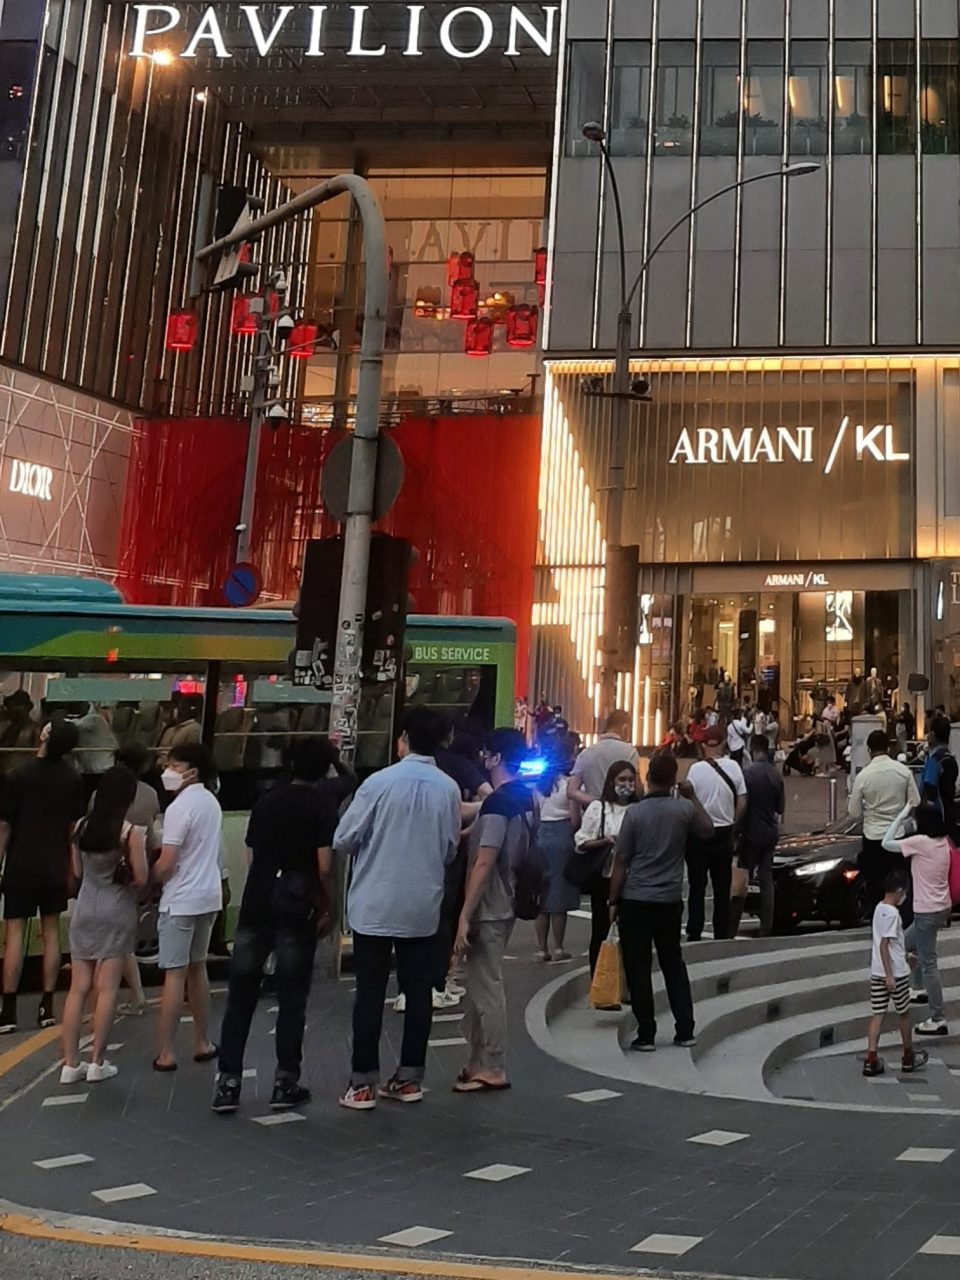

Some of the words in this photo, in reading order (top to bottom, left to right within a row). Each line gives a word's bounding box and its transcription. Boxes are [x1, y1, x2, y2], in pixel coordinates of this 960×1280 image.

[129, 4, 558, 58] PAVILION
[669, 426, 814, 464] ARMANI
[855, 425, 910, 461] KL
[9, 459, 53, 500] DIOR
[764, 574, 804, 586] ARMANI
[415, 646, 438, 660] BUS
[441, 647, 490, 661] SERVICE
